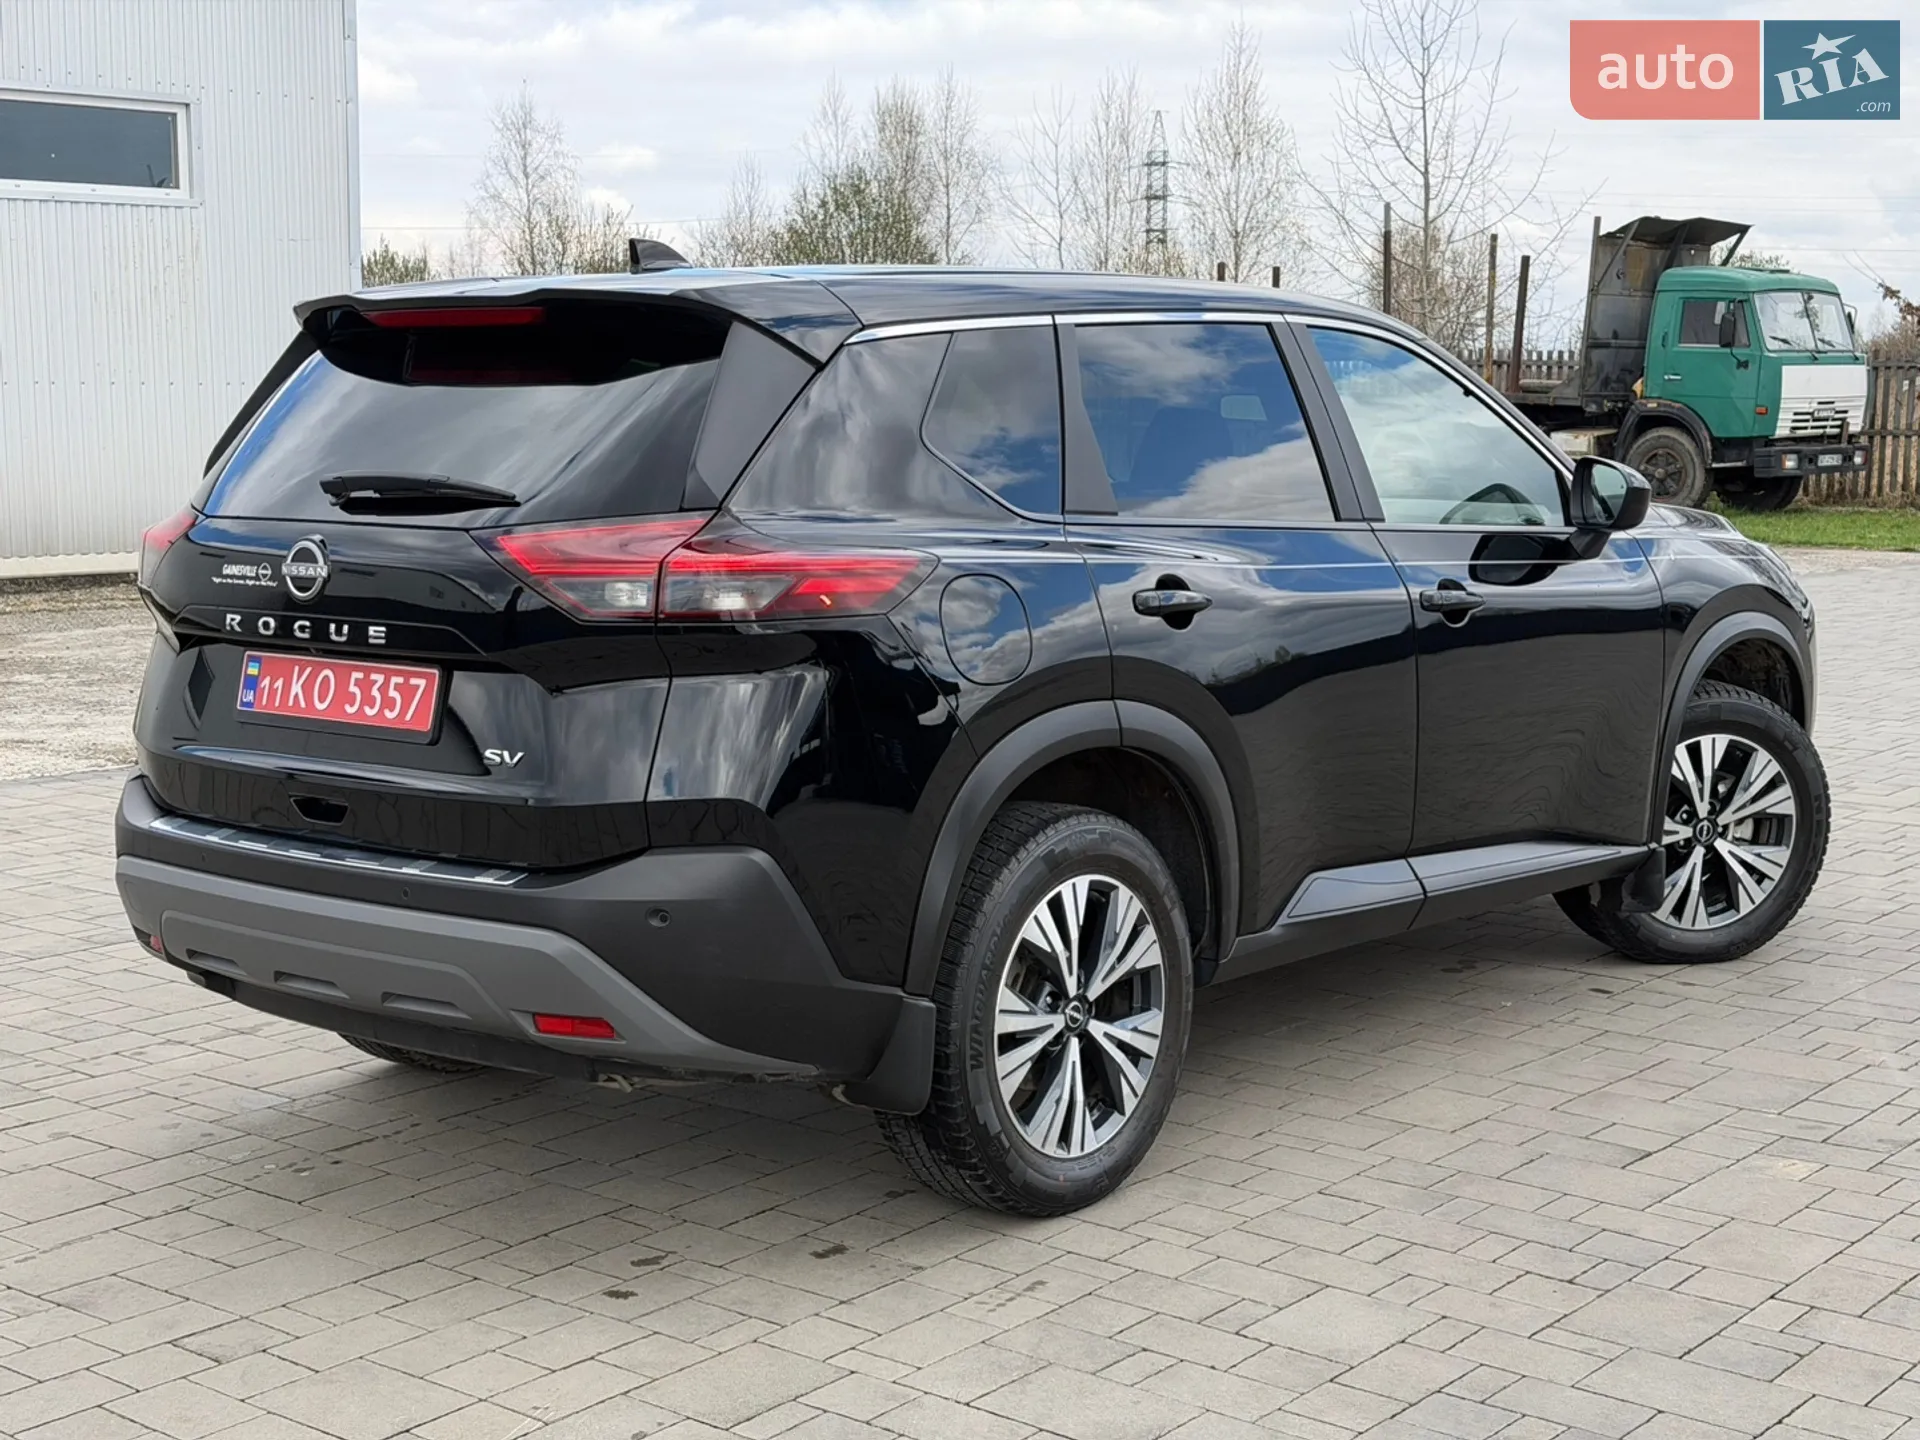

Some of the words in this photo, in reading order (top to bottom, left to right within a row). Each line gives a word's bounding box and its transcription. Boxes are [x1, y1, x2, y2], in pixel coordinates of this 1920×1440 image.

[282, 562, 327, 579] NISSAN
[225, 613, 387, 644] ROGUE
[241, 688, 255, 703] UA
[344, 671, 427, 721] 5357
[483, 748, 525, 768] SV
